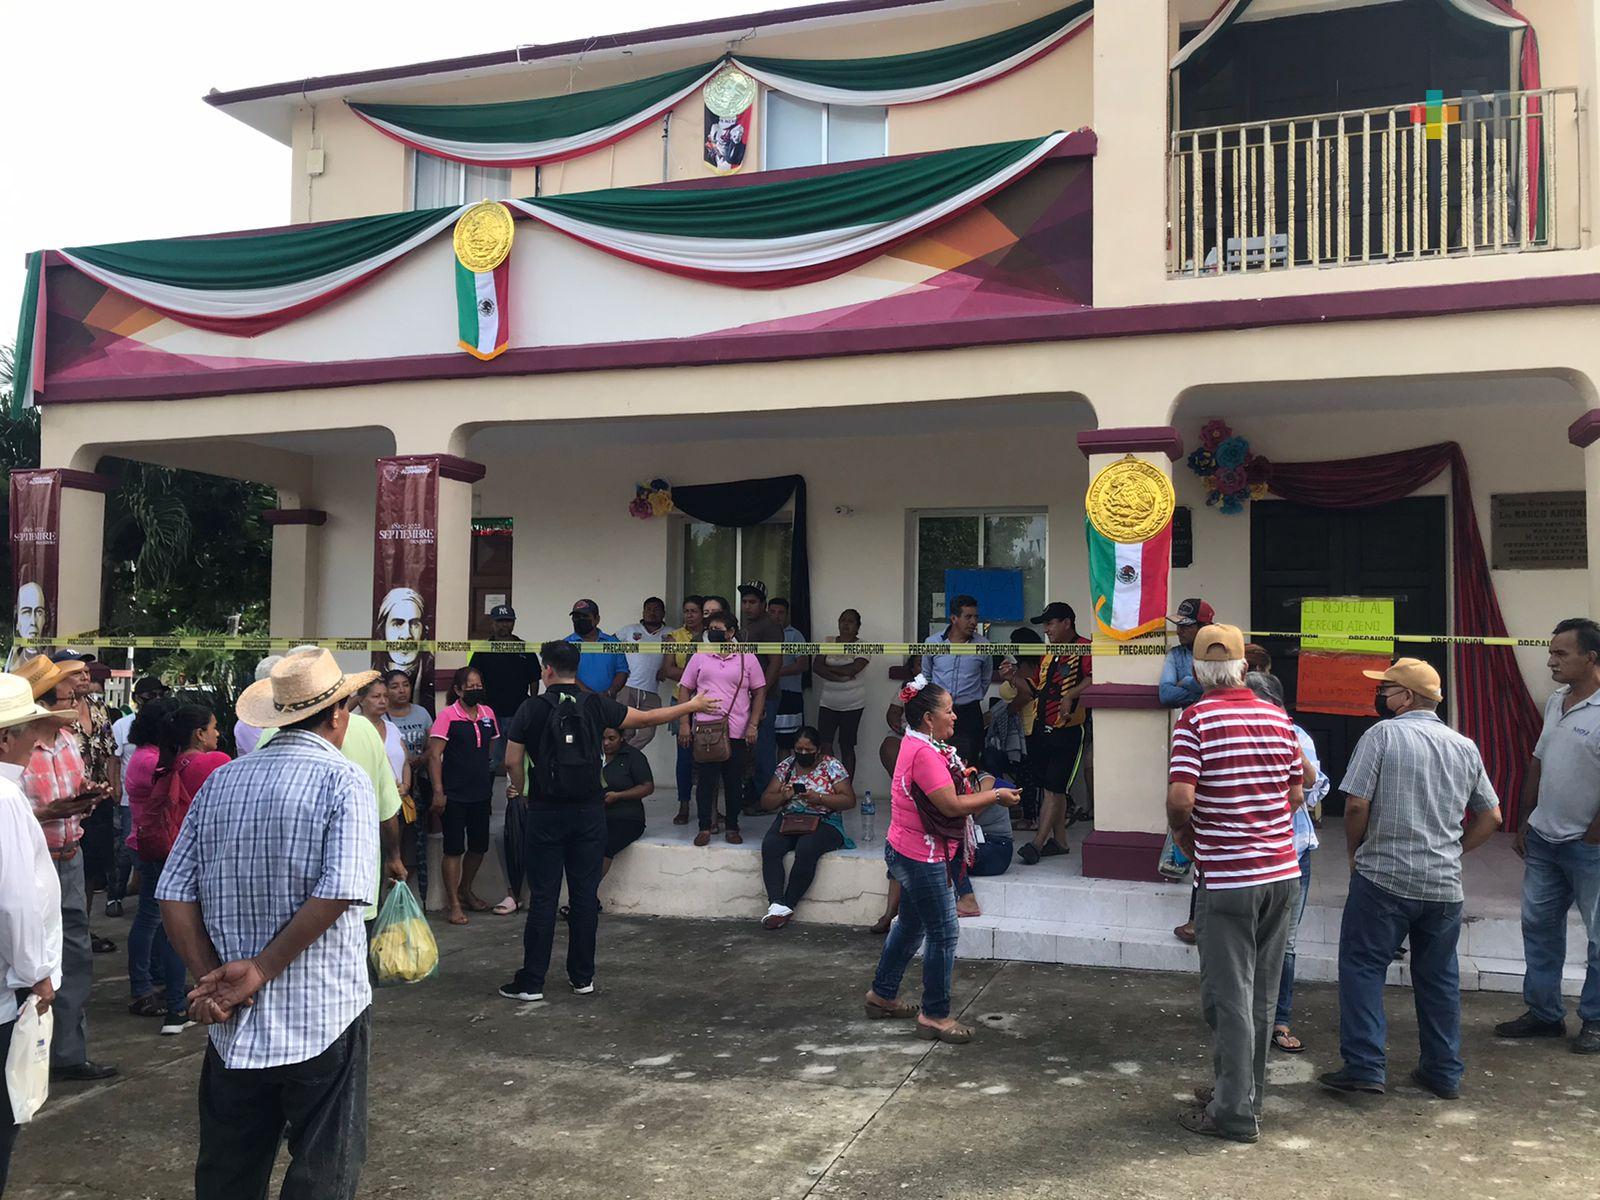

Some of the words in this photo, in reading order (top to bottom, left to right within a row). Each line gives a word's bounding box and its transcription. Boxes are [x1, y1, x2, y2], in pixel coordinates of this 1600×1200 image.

[379, 529, 434, 539] SEPTIEMBRE
[1303, 601, 1316, 614] EL
[1323, 601, 1365, 614] RESPETO
[1371, 602, 1384, 614] AL
[1303, 620, 1343, 631] DERECHO
[336, 641, 367, 650] PRECAUCION
[386, 641, 418, 650] PRECAUCION
[437, 642, 471, 651] PRECAUCION
[491, 642, 525, 652] PRECAUCION
[603, 643, 639, 653] PRECAUCION
[661, 643, 697, 653] PRECAUCION
[720, 643, 758, 653] PRECAUCION
[781, 644, 820, 654] PRECAUCION
[844, 644, 884, 654] PRECAUCION
[909, 645, 950, 655] PRECAUCION
[976, 645, 1019, 655] PRECAUCION
[1046, 645, 1091, 655] PRECAUCION
[1119, 645, 1165, 655] PRECAUCION
